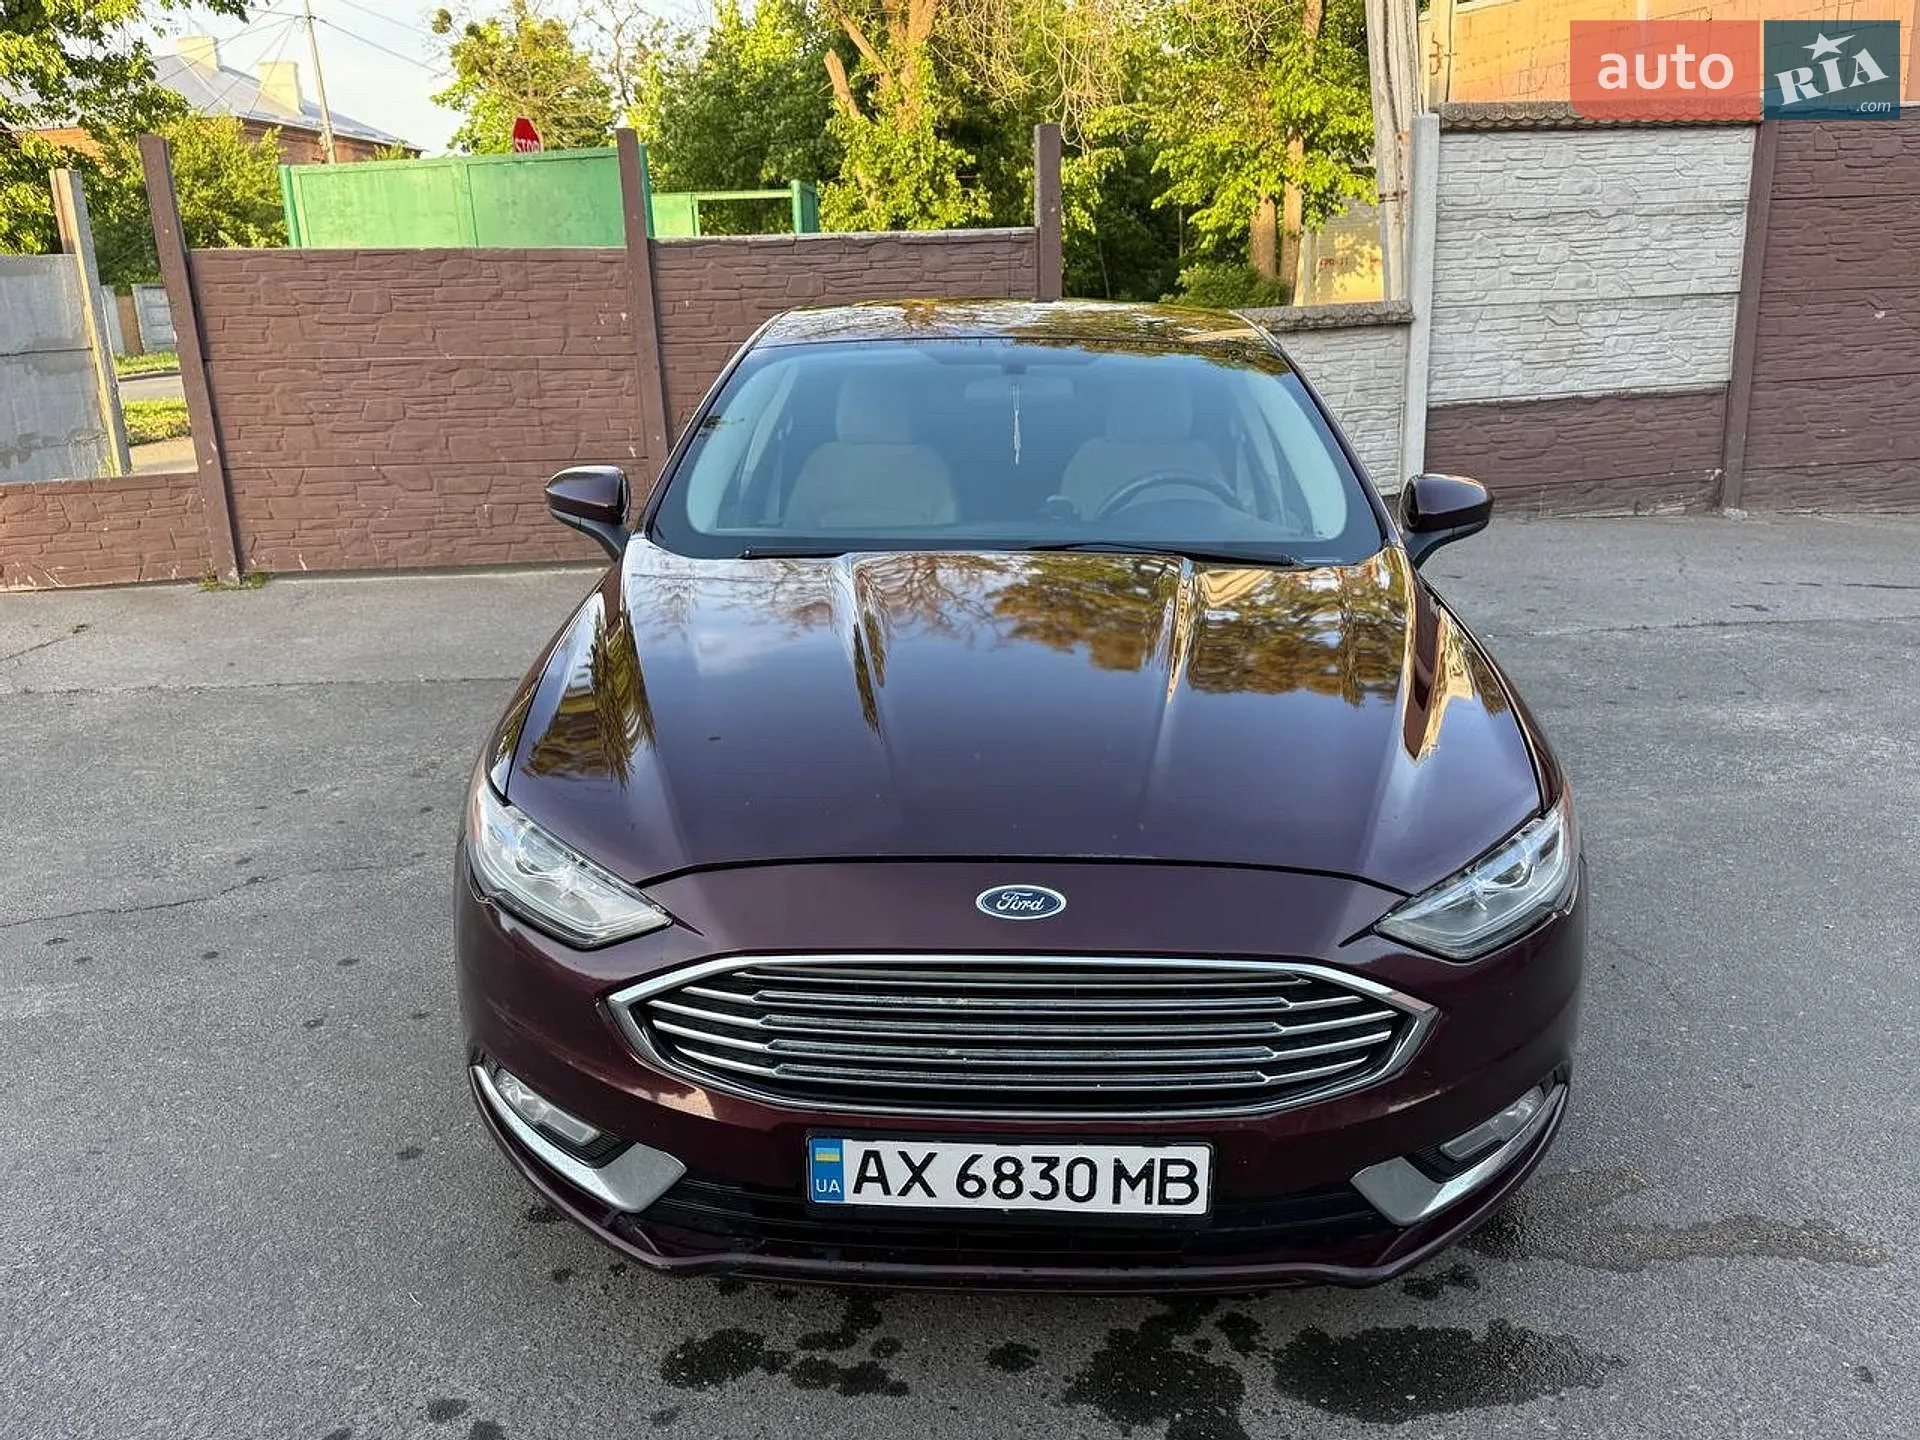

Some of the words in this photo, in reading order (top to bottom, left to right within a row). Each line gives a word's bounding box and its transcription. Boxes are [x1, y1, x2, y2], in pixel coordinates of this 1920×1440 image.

[514, 137, 540, 153] STOP
[995, 891, 1046, 911] Ford
[815, 1178, 841, 1193] UA
[852, 1149, 938, 1198] AX
[955, 1153, 1098, 1203] 6830
[1111, 1156, 1200, 1206] MB
